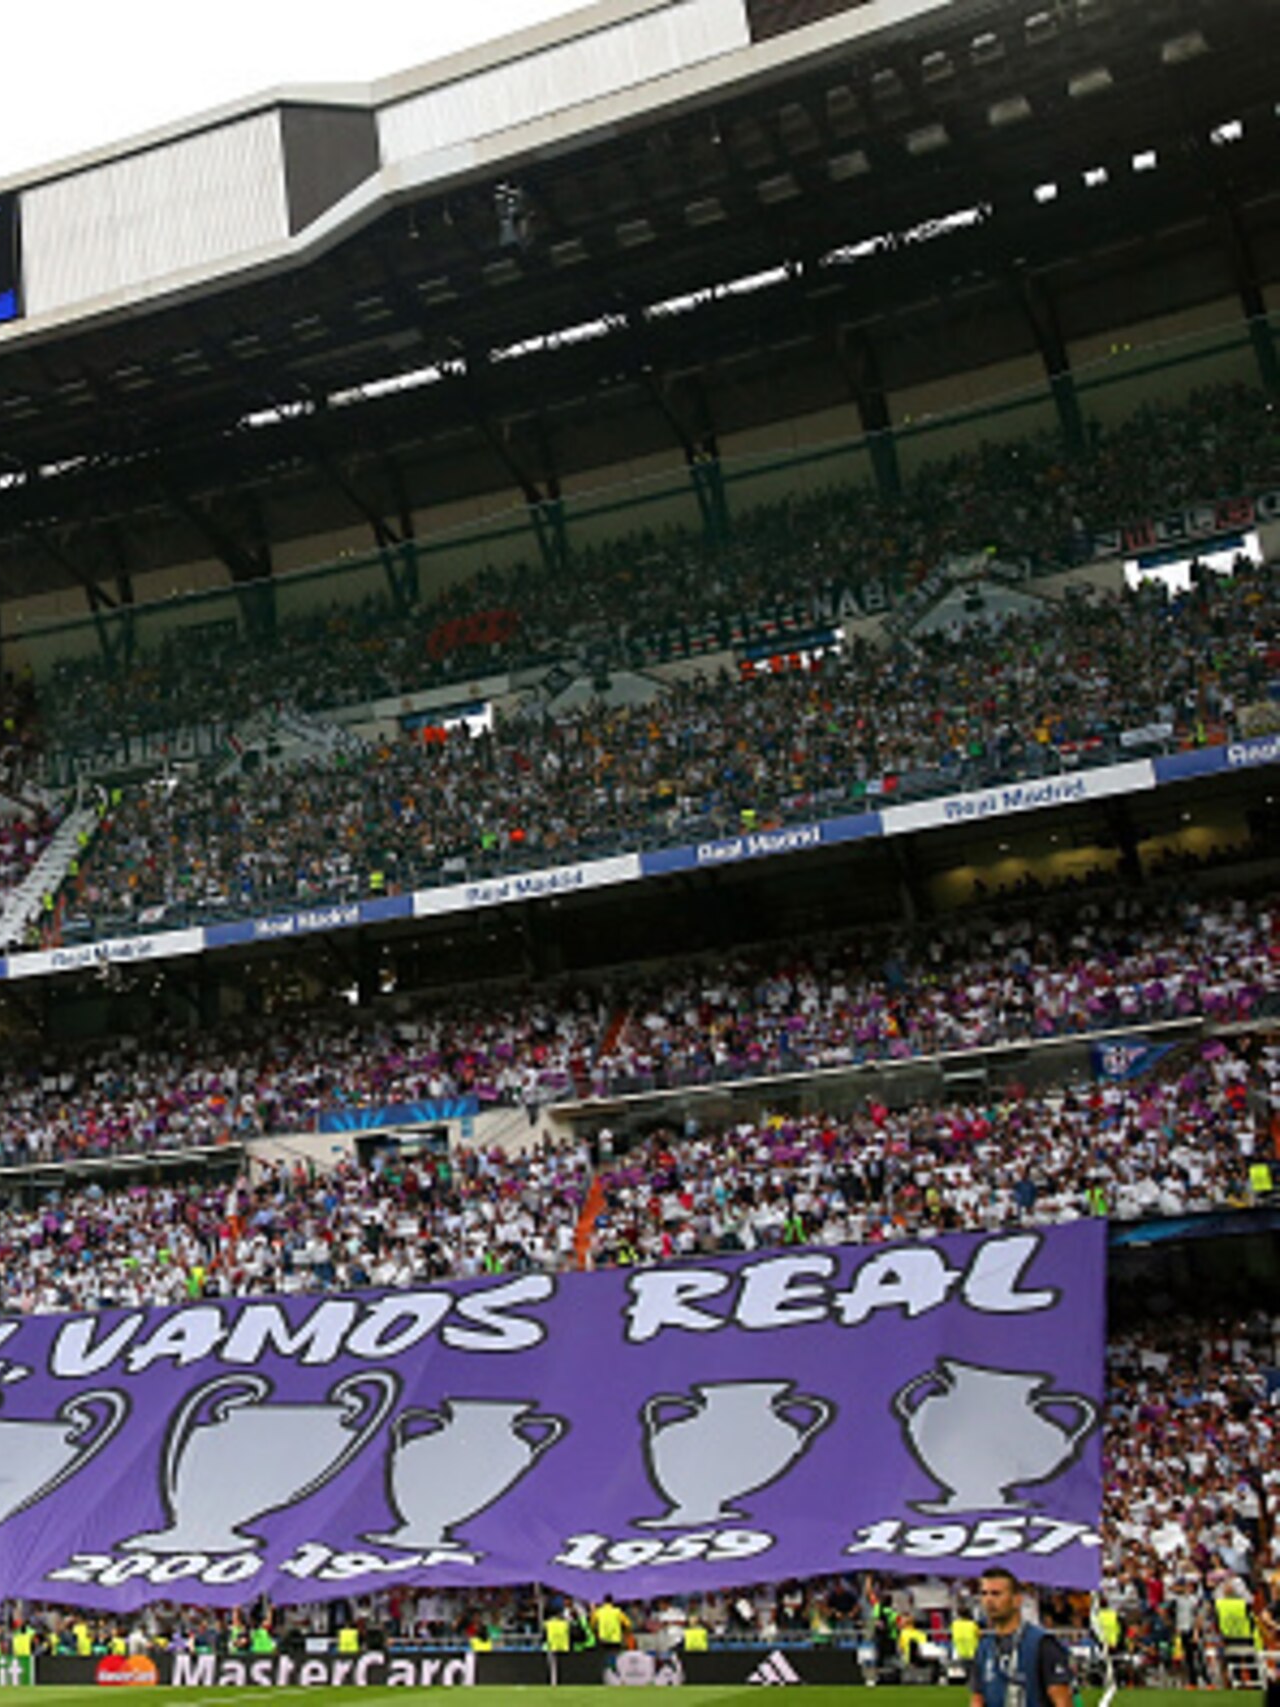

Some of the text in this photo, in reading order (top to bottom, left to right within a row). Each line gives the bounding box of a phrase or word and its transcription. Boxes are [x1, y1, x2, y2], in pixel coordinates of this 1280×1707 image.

[1003, 777, 1086, 808] Madrid
[696, 828, 820, 862] Real Madrid
[50, 1273, 556, 1377] VAMOS
[625, 1232, 1056, 1342] REAL
[46, 1552, 263, 1586] 2000
[554, 1530, 776, 1571] 1959
[171, 1651, 477, 1686] MasterCard
